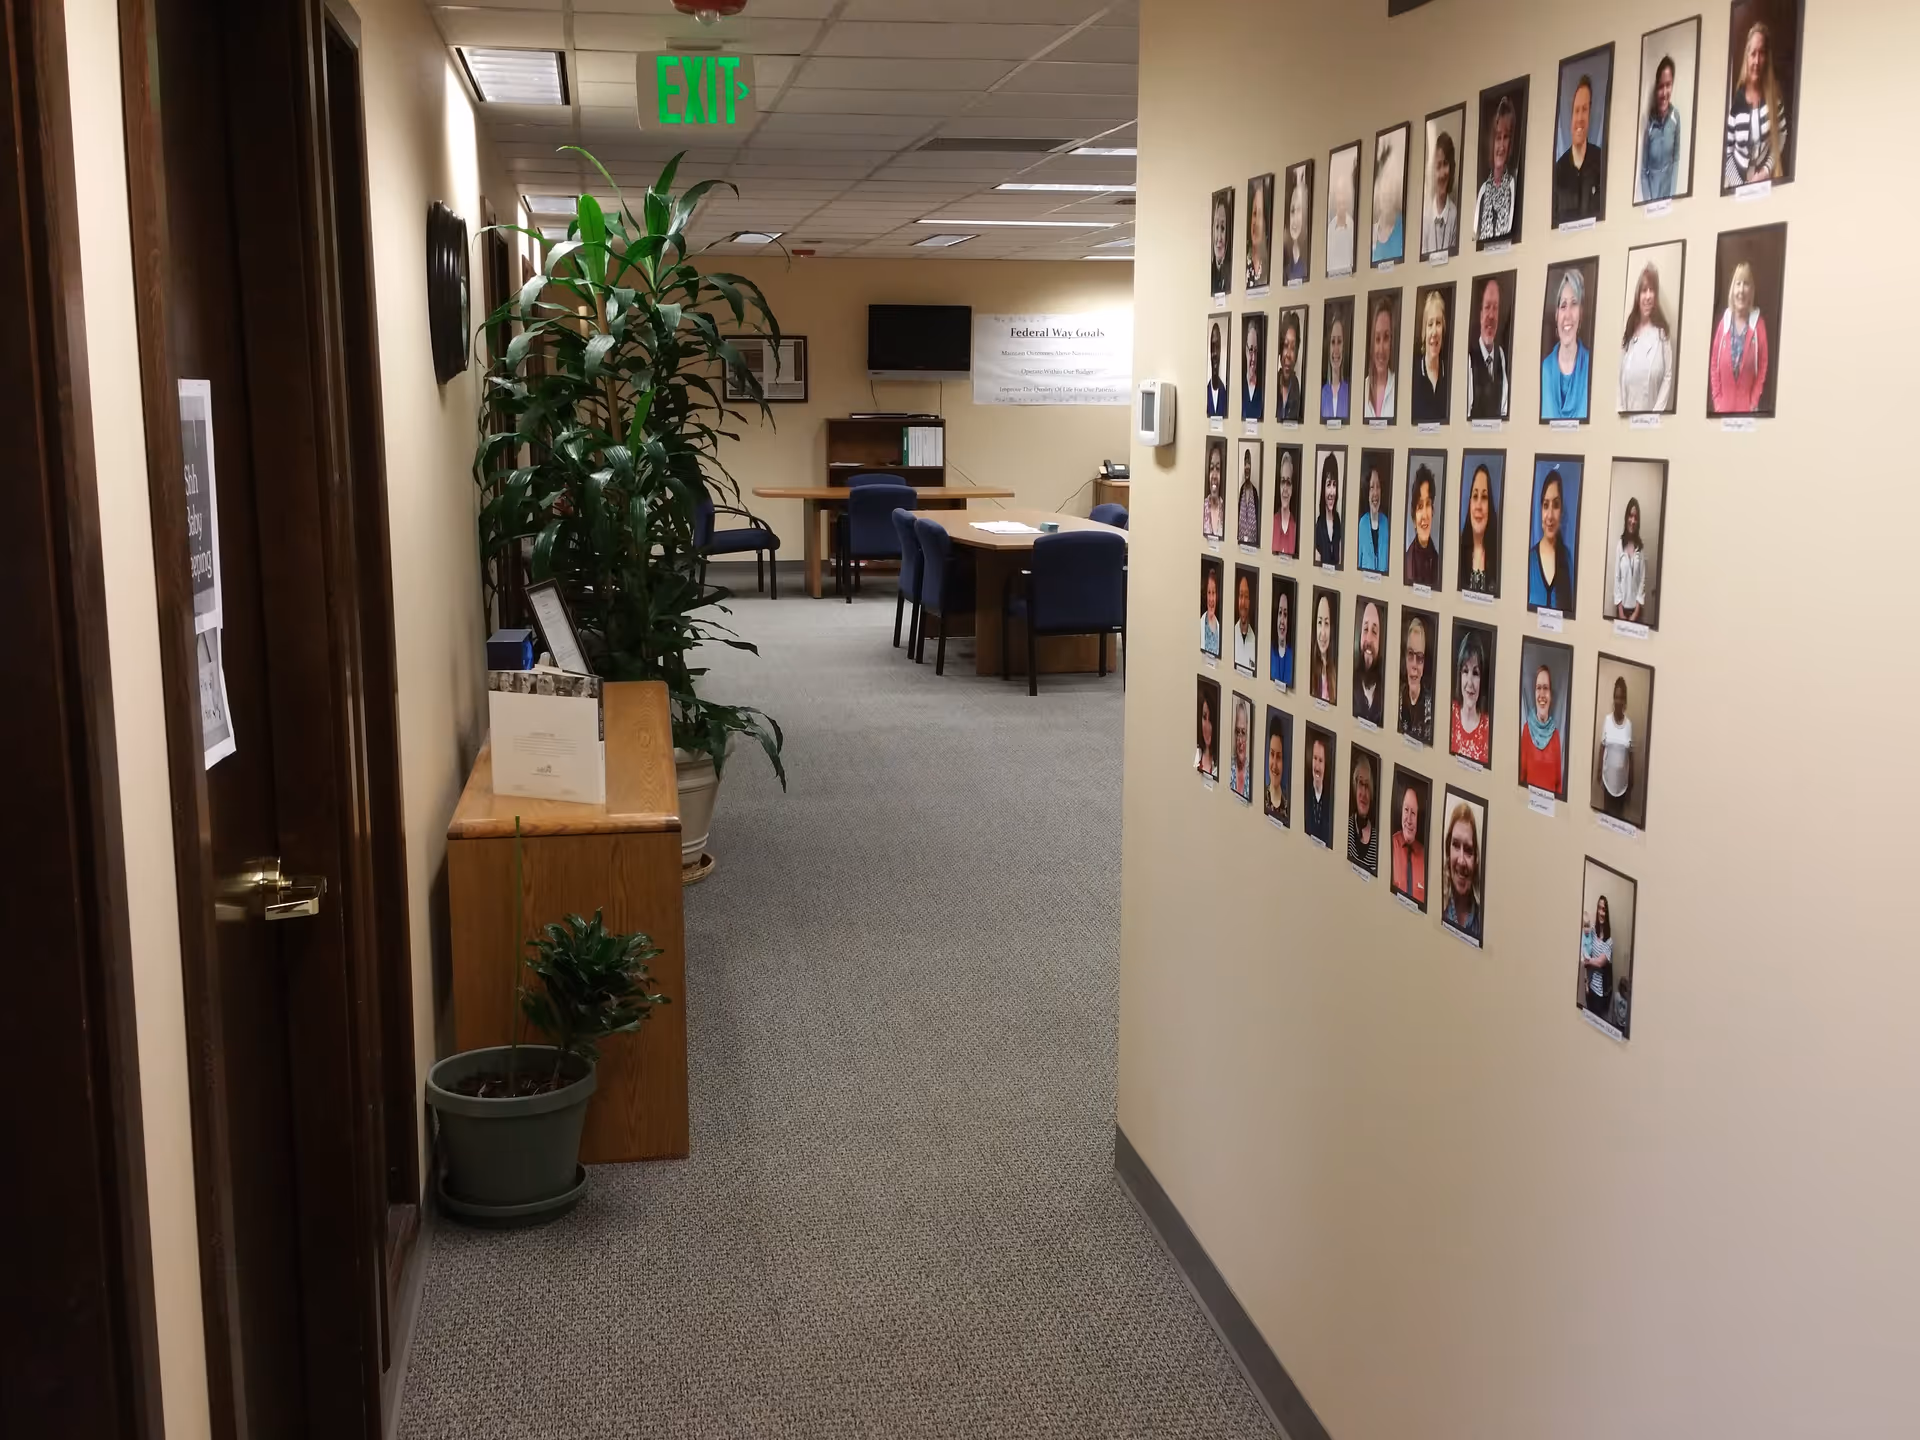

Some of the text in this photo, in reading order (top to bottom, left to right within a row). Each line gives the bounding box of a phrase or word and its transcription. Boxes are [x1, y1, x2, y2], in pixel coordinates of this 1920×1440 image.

[656, 55, 740, 124] EXIT
[1010, 327, 1105, 340] Federal Way Goals
[184, 463, 199, 496] Shh
